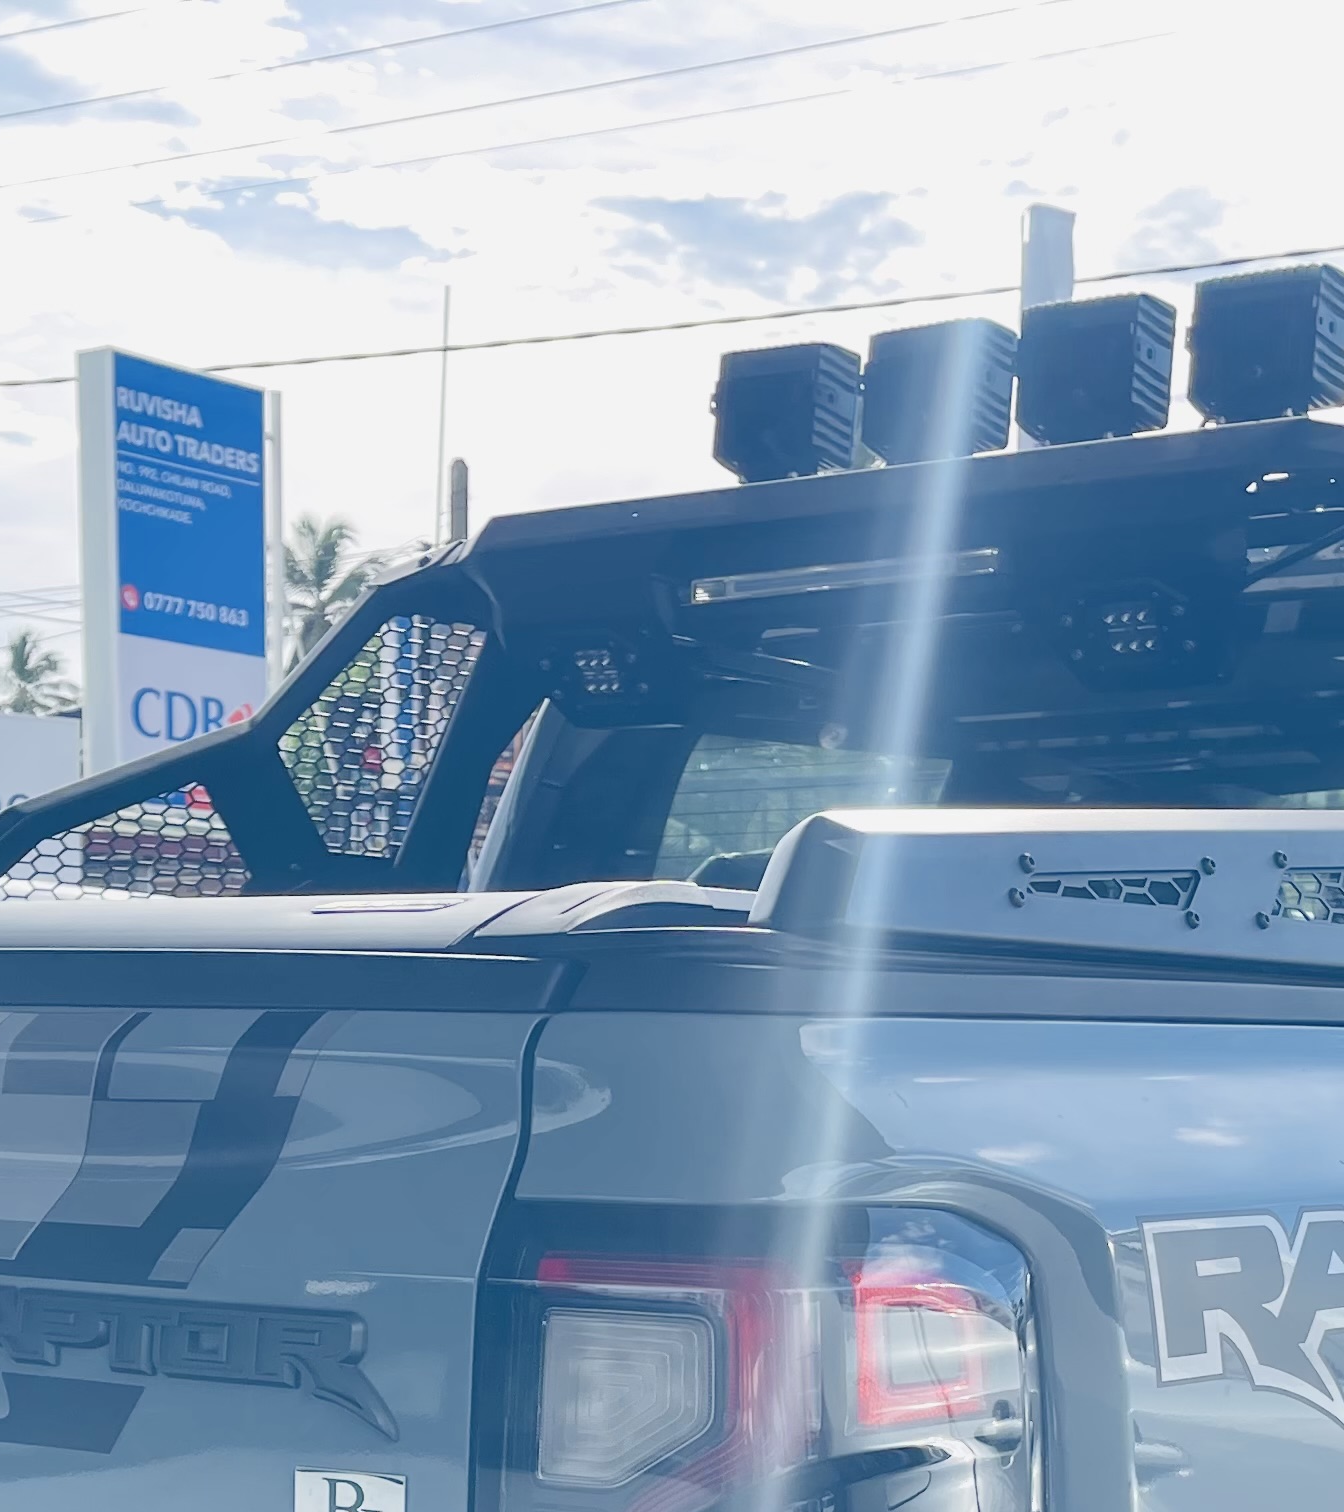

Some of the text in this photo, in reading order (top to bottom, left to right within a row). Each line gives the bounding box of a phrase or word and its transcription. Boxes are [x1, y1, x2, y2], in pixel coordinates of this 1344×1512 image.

[116, 386, 203, 428] RUVISHA
[116, 420, 260, 473] AUTO TRADERS
[143, 591, 185, 615] 0777
[186, 599, 217, 621] 750
[132, 687, 224, 741] CDB
